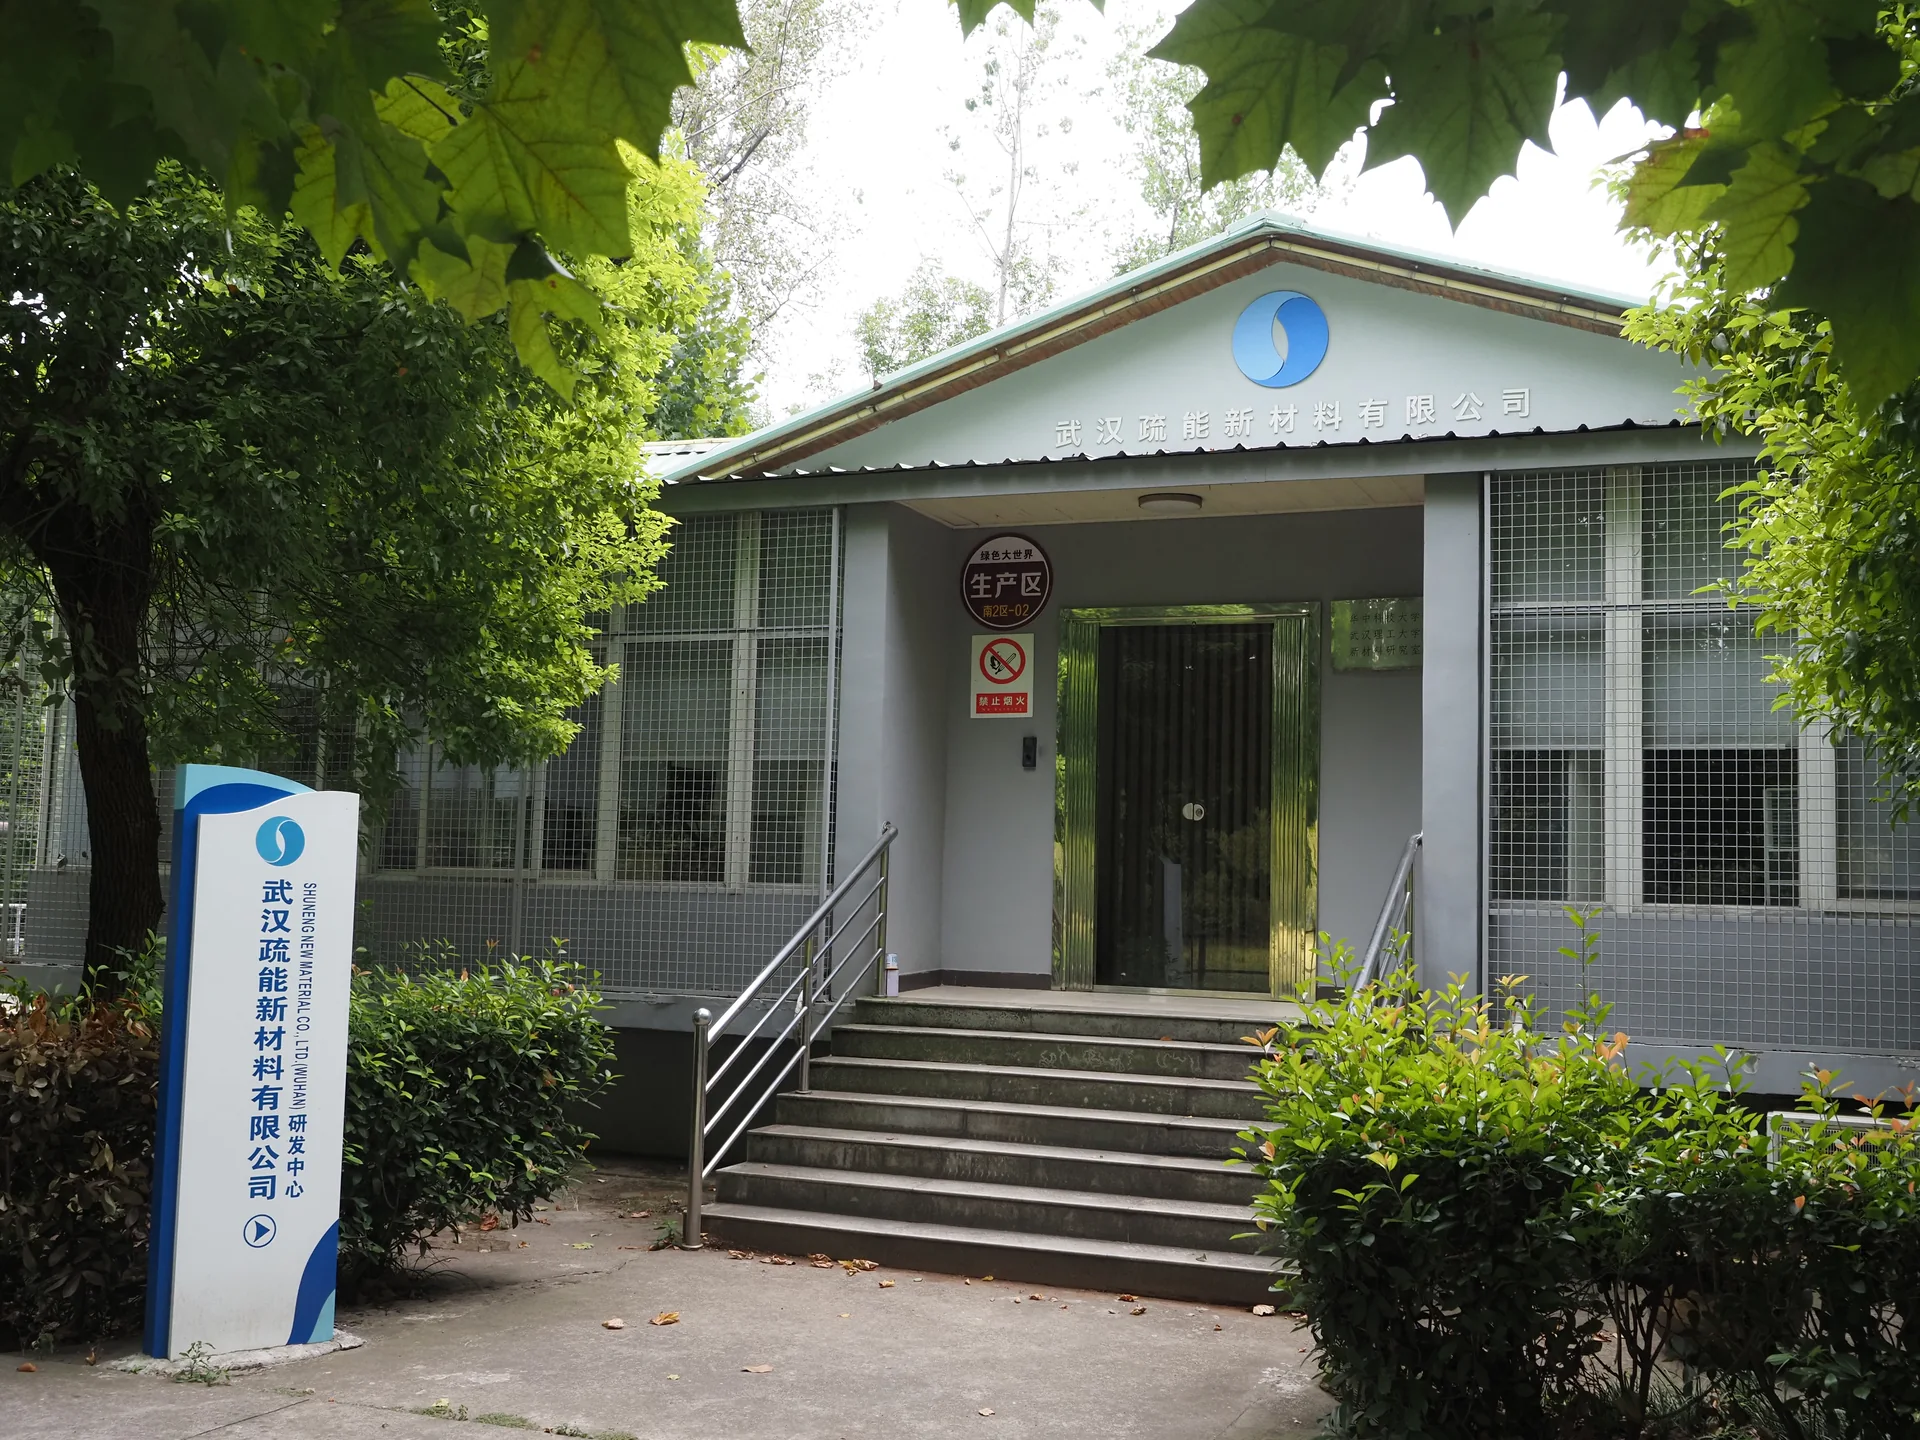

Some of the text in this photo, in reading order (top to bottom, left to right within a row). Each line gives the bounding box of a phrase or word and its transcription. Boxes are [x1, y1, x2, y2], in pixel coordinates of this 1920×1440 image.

[1055, 388, 1531, 448] 武汉疏能新材料有限公司
[980, 549, 1034, 561] 绿色大世界
[970, 572, 1042, 599] 生产区
[983, 604, 1030, 617] 南2区-02
[1350, 628, 1421, 640] 武汉理工大学
[979, 696, 1025, 706] 禁止烟火
[301, 882, 317, 933] SHUNENG
[300, 935, 314, 959] NEW
[297, 961, 313, 1014] MATERIAL
[293, 1016, 310, 1038] CO.,
[247, 879, 294, 1201] 武汉疏能新材料有限公司
[285, 1113, 308, 1198] 研发中心
